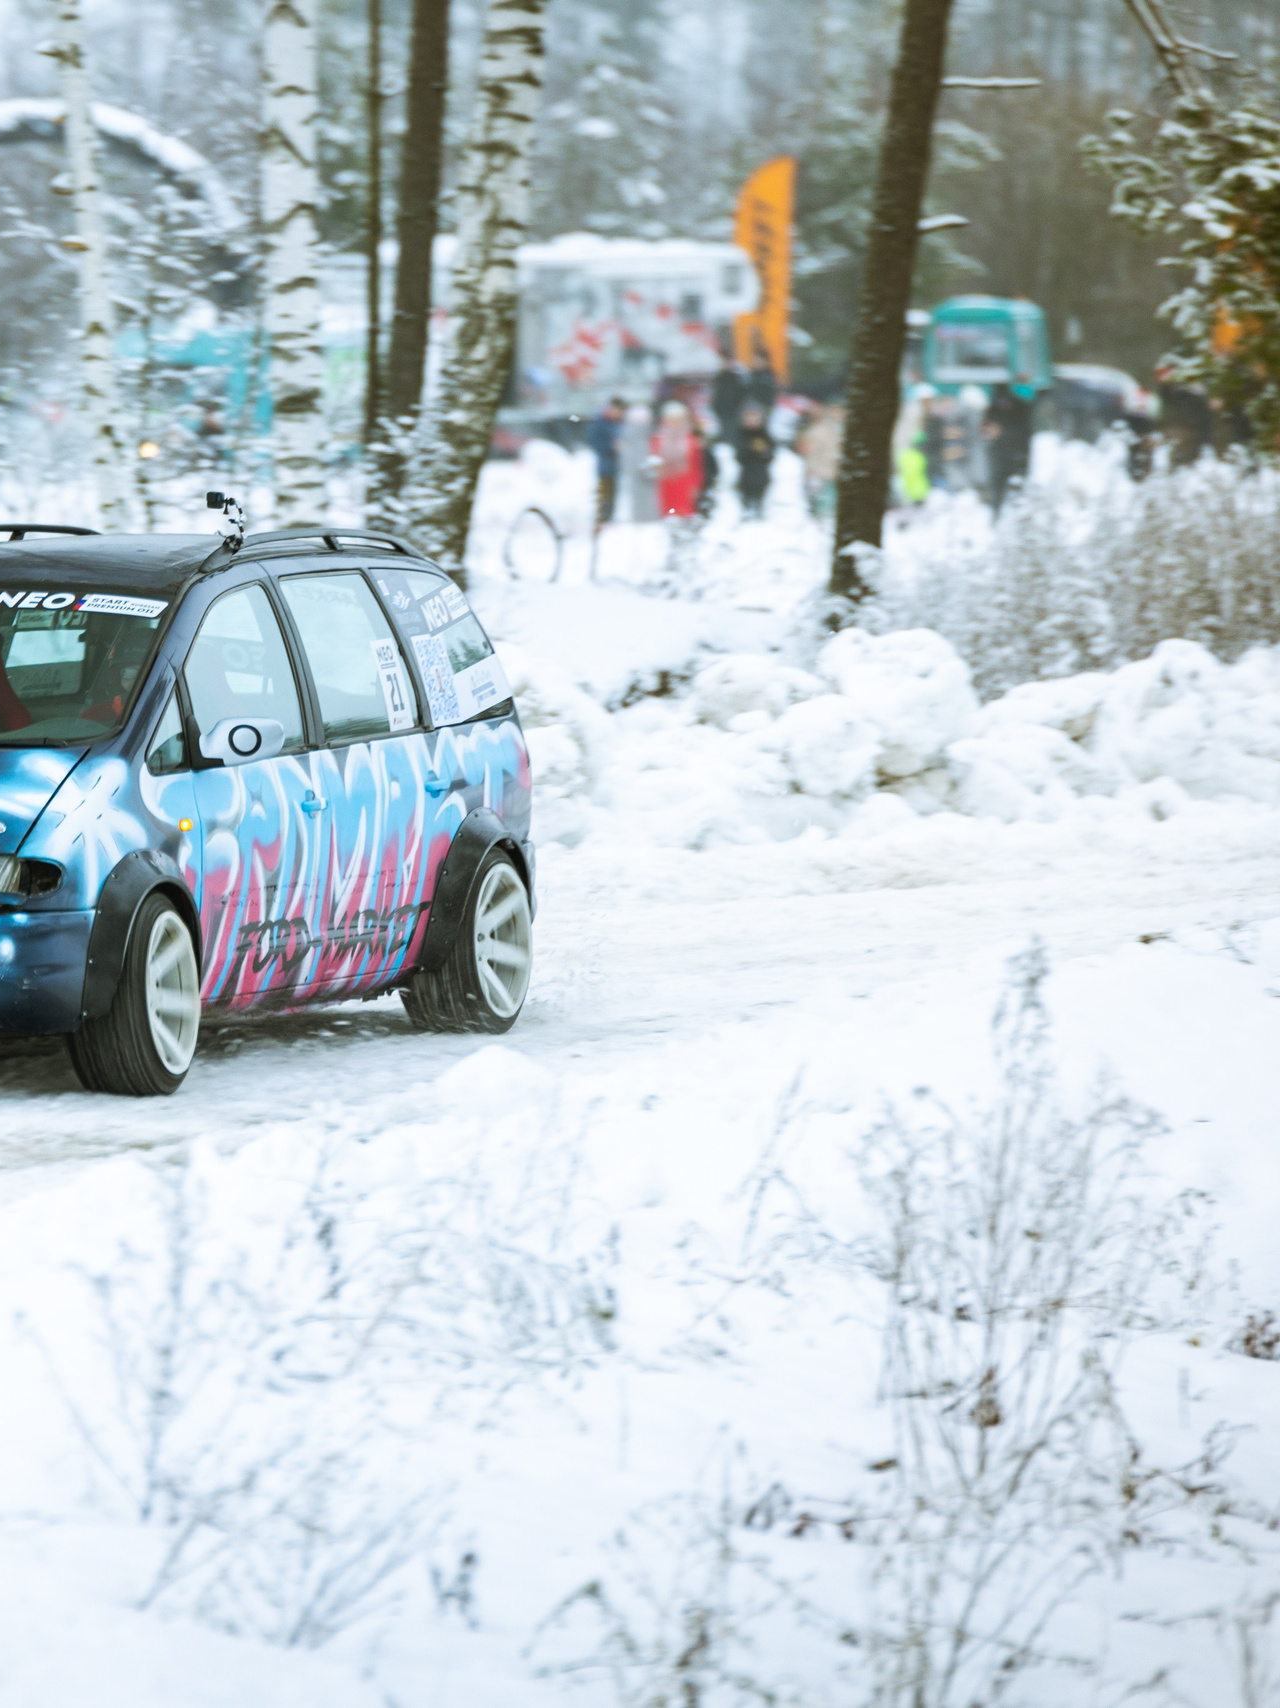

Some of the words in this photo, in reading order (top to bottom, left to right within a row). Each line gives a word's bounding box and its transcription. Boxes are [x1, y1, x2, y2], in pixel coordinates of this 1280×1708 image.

[86, 603, 135, 611] PREMIUM
[92, 597, 131, 605] START
[420, 595, 451, 632] NEO
[376, 645, 394, 663] NEO
[386, 673, 405, 712] 21
[235, 900, 433, 974] FORD-MARKET
